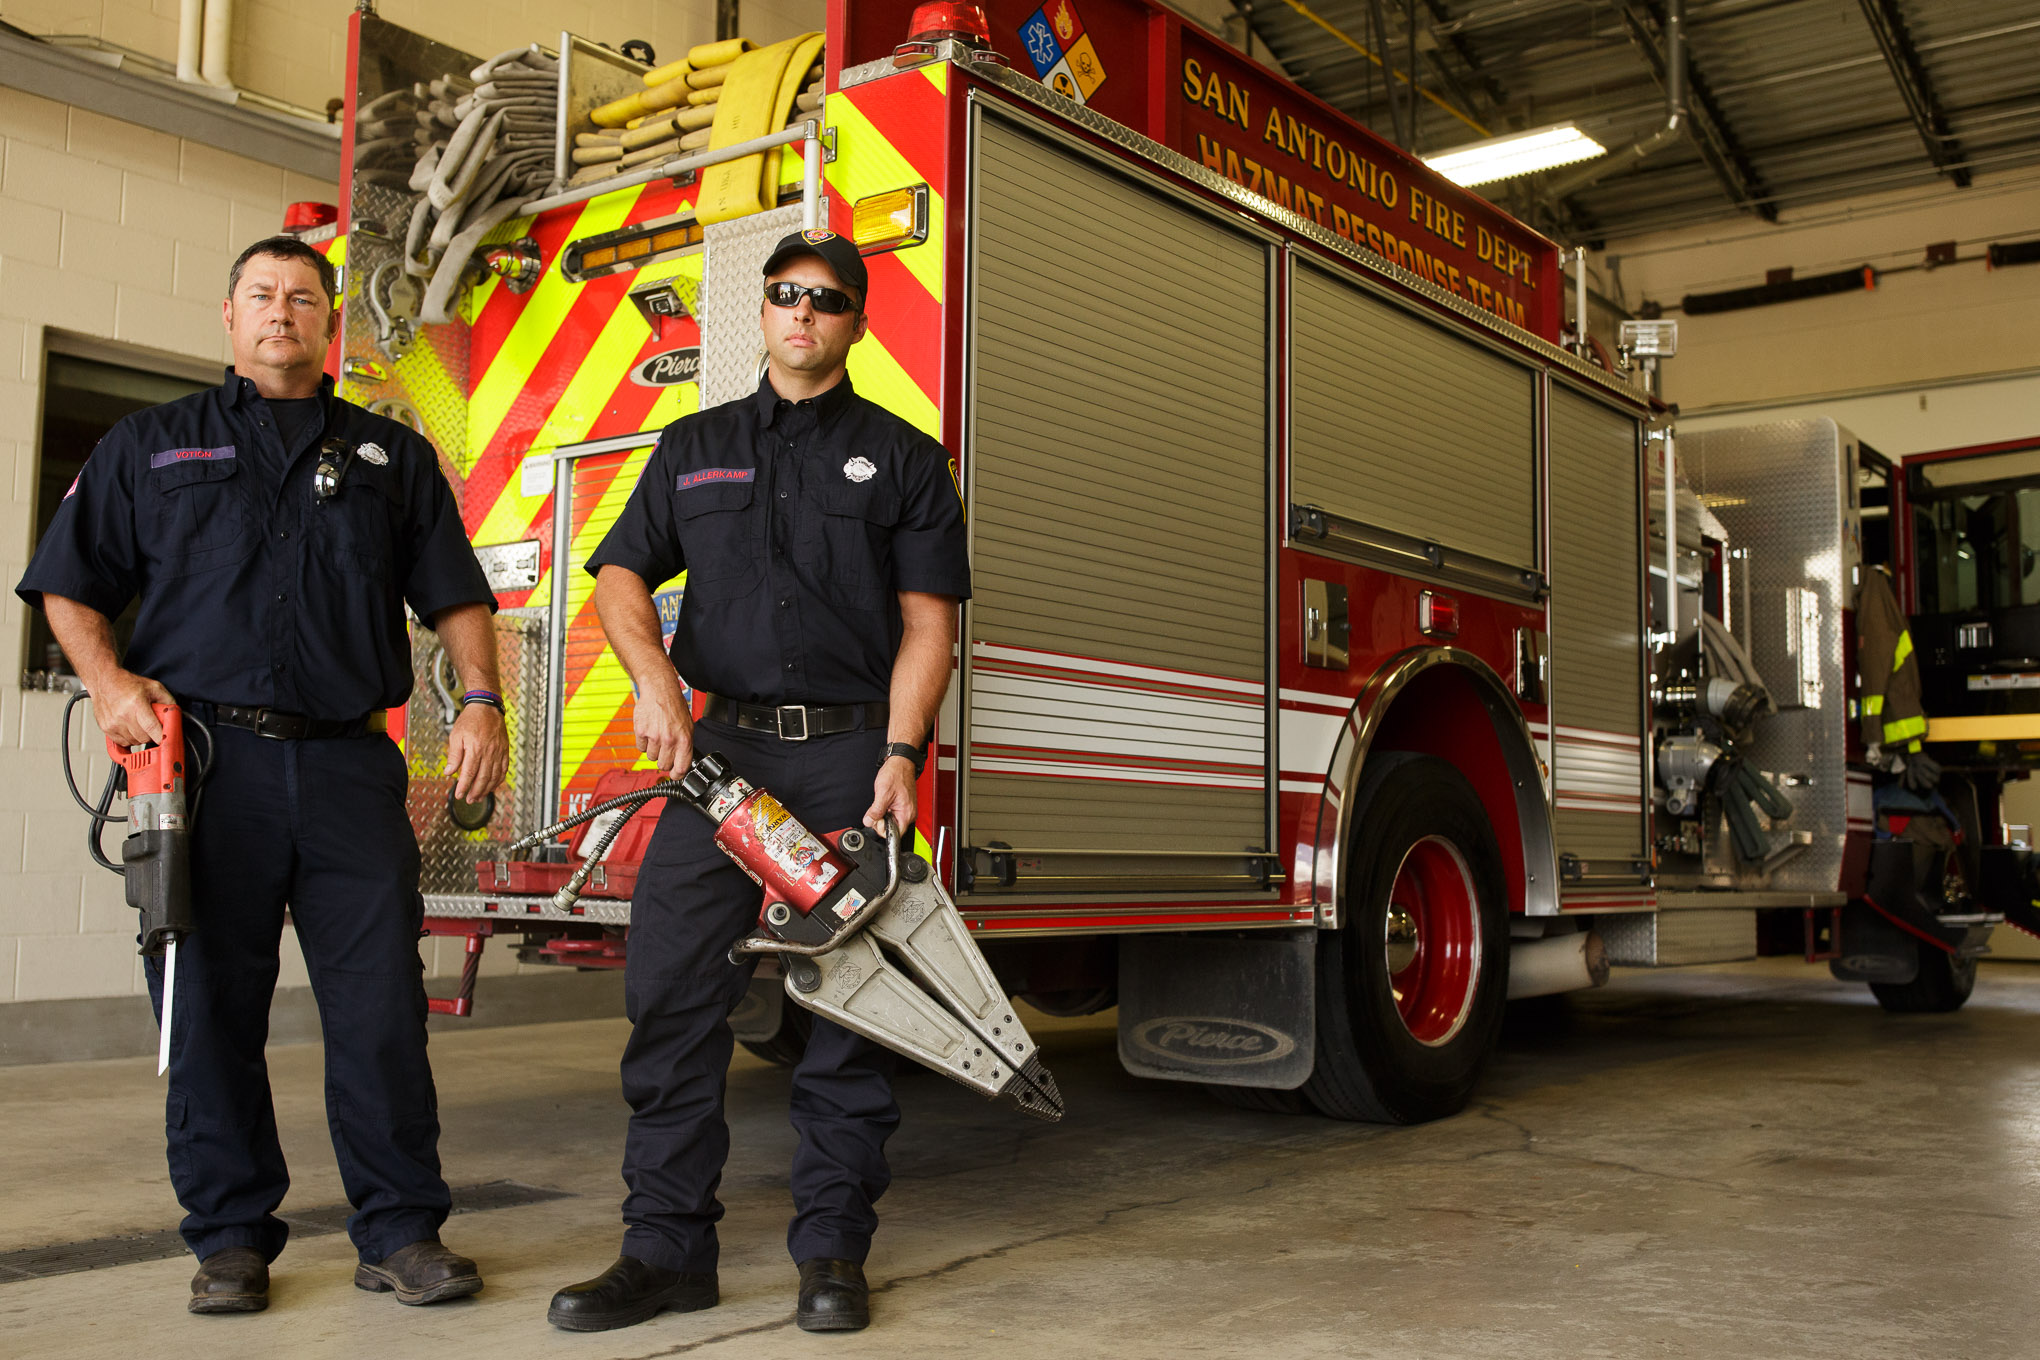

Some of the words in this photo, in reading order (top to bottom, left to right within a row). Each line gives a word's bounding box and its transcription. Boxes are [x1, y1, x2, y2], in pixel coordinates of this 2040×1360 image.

[1183, 58, 1250, 130] SAN
[1263, 106, 1399, 209] ANTONIO
[1409, 186, 1466, 250] FIRE
[1476, 225, 1537, 290] DEPT.
[1198, 133, 1326, 222] HAZMAT
[1466, 275, 1527, 330] TEAM
[651, 355, 701, 383] Pierc
[175, 450, 213, 459] VOTION
[683, 477, 691, 486] J.
[693, 470, 748, 484] ALLERKAMP
[1158, 1022, 1264, 1052] Pierce
